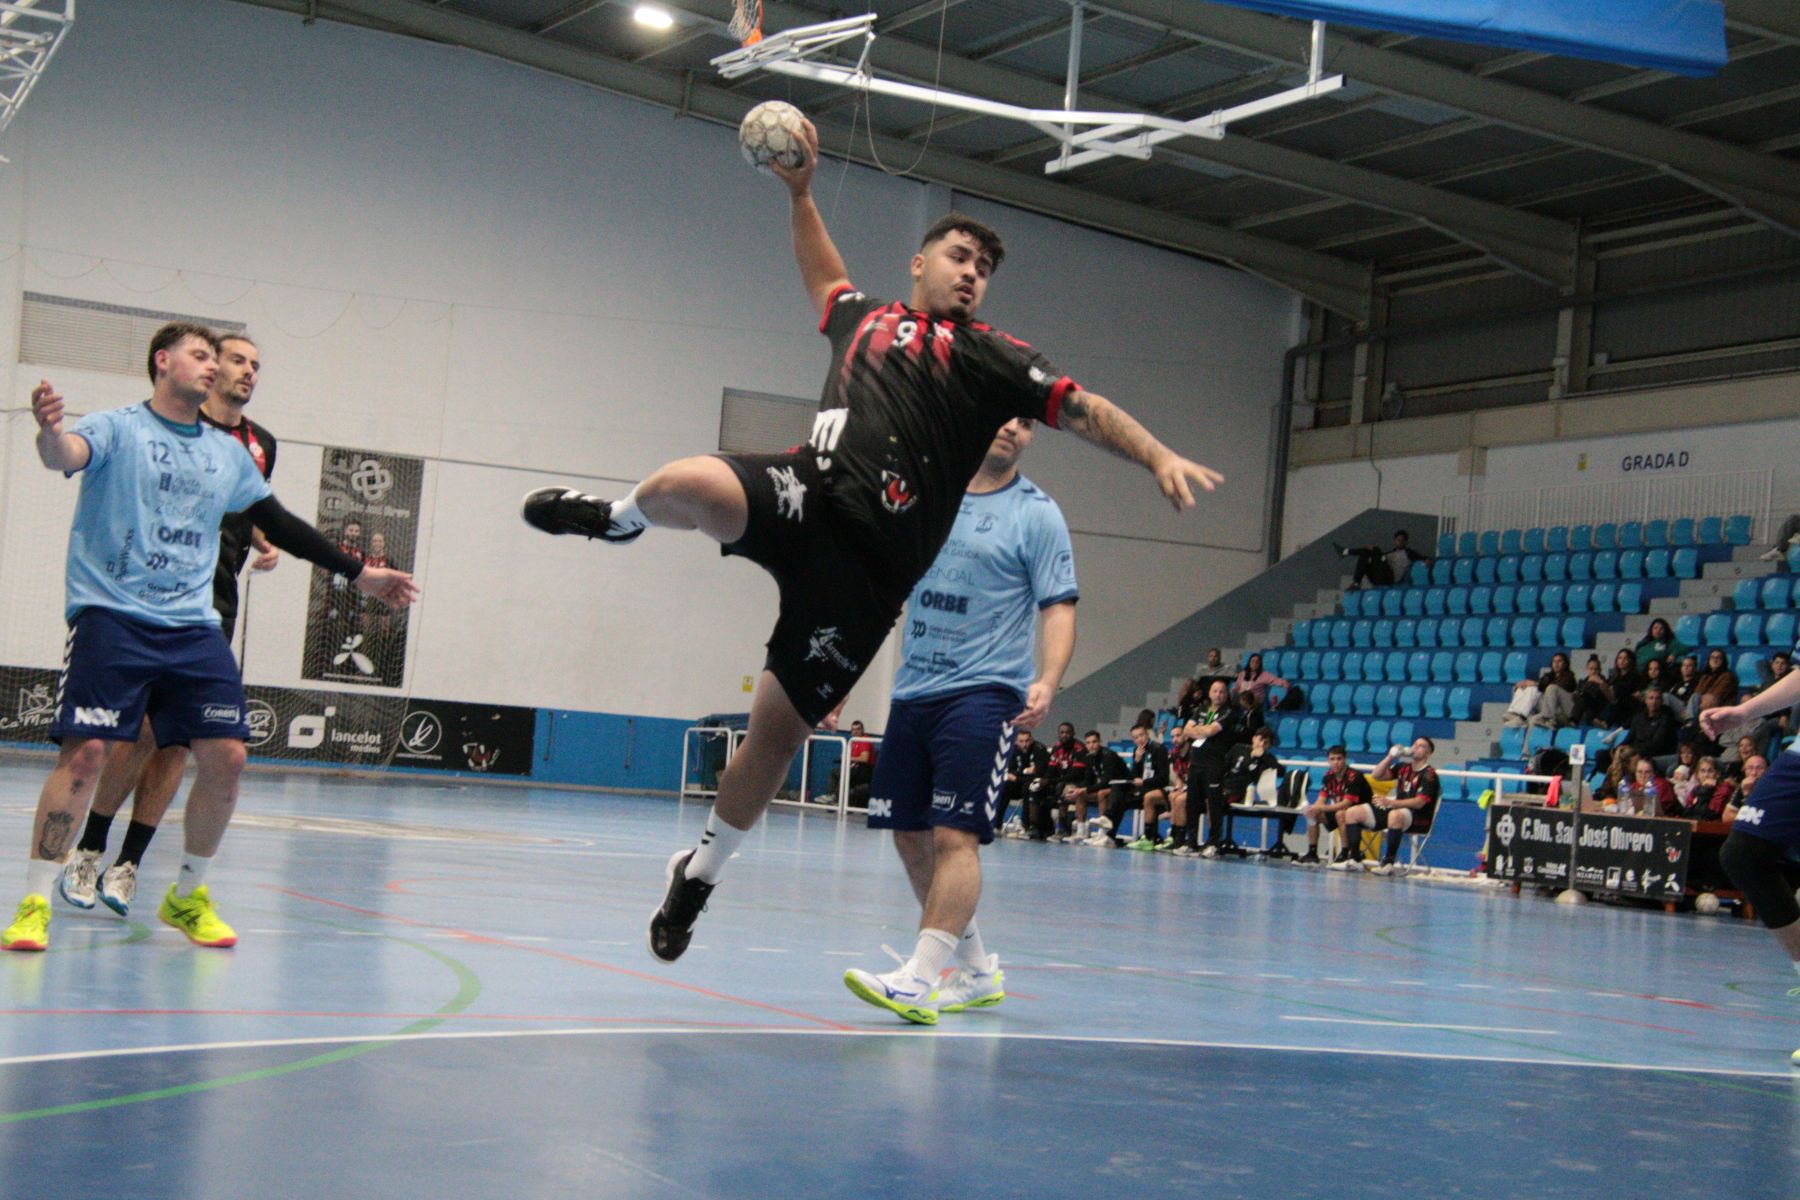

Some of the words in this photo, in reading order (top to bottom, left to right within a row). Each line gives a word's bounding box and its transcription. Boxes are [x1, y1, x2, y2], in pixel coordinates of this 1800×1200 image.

[892, 321, 918, 347] 9
[148, 440, 172, 464] 12
[1622, 453, 1675, 471] GRADA
[1679, 451, 1689, 467] D
[921, 588, 970, 615] ORBE
[74, 706, 121, 728] NOX
[331, 727, 382, 745] lancelot
[350, 744, 381, 754] medios
[1520, 817, 1553, 843] C.Bm.
[1579, 824, 1608, 848] José
[1610, 826, 1654, 853] Obrero
